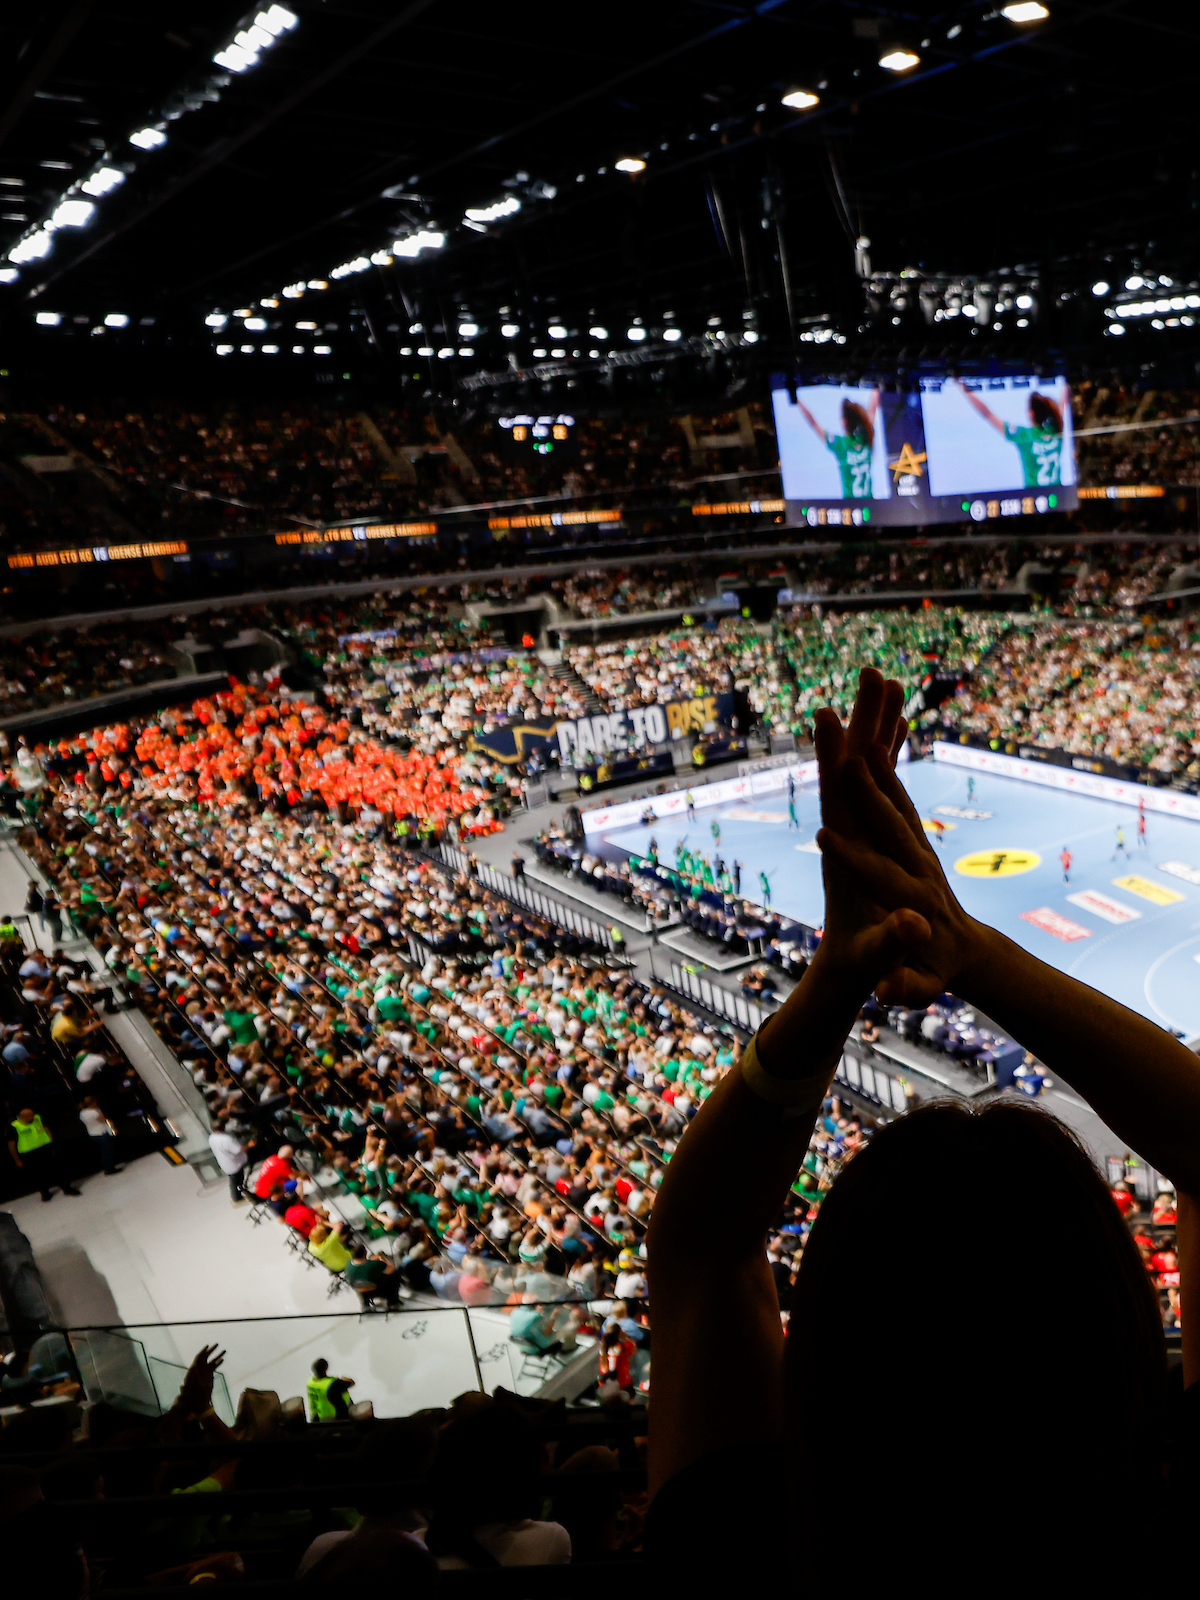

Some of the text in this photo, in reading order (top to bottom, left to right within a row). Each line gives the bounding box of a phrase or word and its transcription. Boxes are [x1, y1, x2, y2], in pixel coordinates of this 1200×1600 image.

[59, 549, 79, 565] ETO
[93, 546, 109, 562] VS
[108, 544, 143, 561] ODENSE
[556, 695, 719, 758] DARE TO RISE
